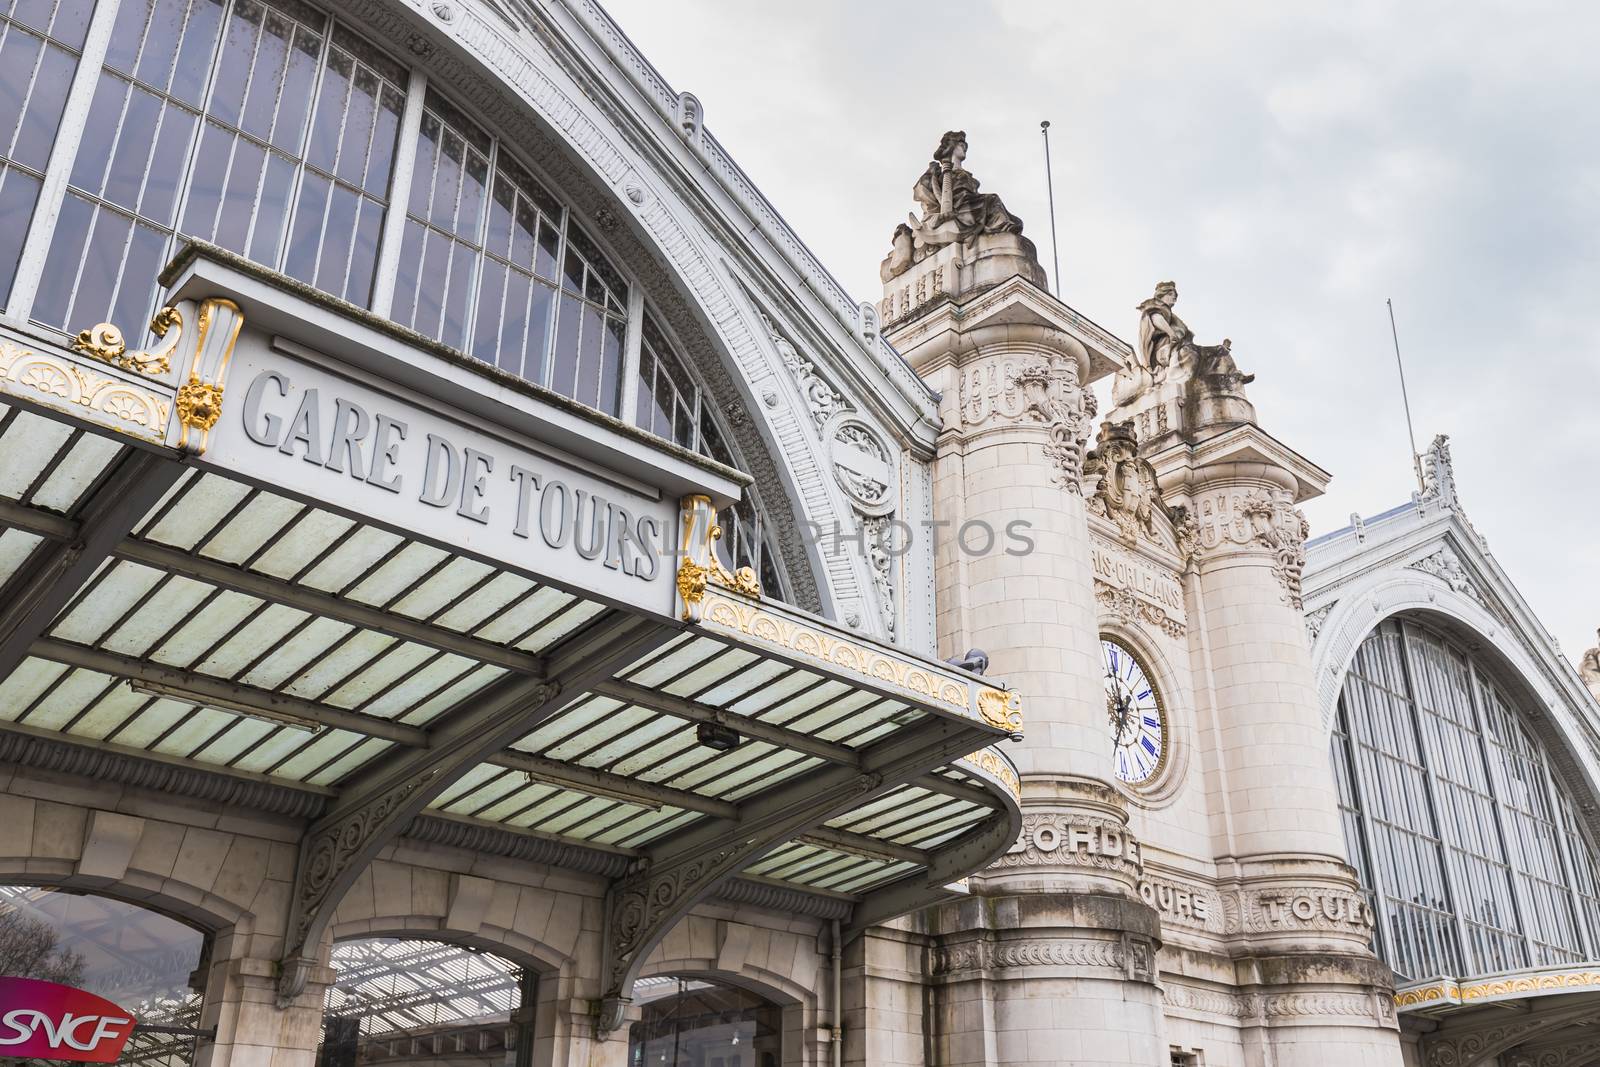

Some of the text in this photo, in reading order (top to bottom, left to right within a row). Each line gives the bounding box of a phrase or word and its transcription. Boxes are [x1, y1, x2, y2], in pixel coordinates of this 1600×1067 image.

[243, 370, 660, 582] GARE DE TOURS
[0, 1009, 130, 1052] SNCF
